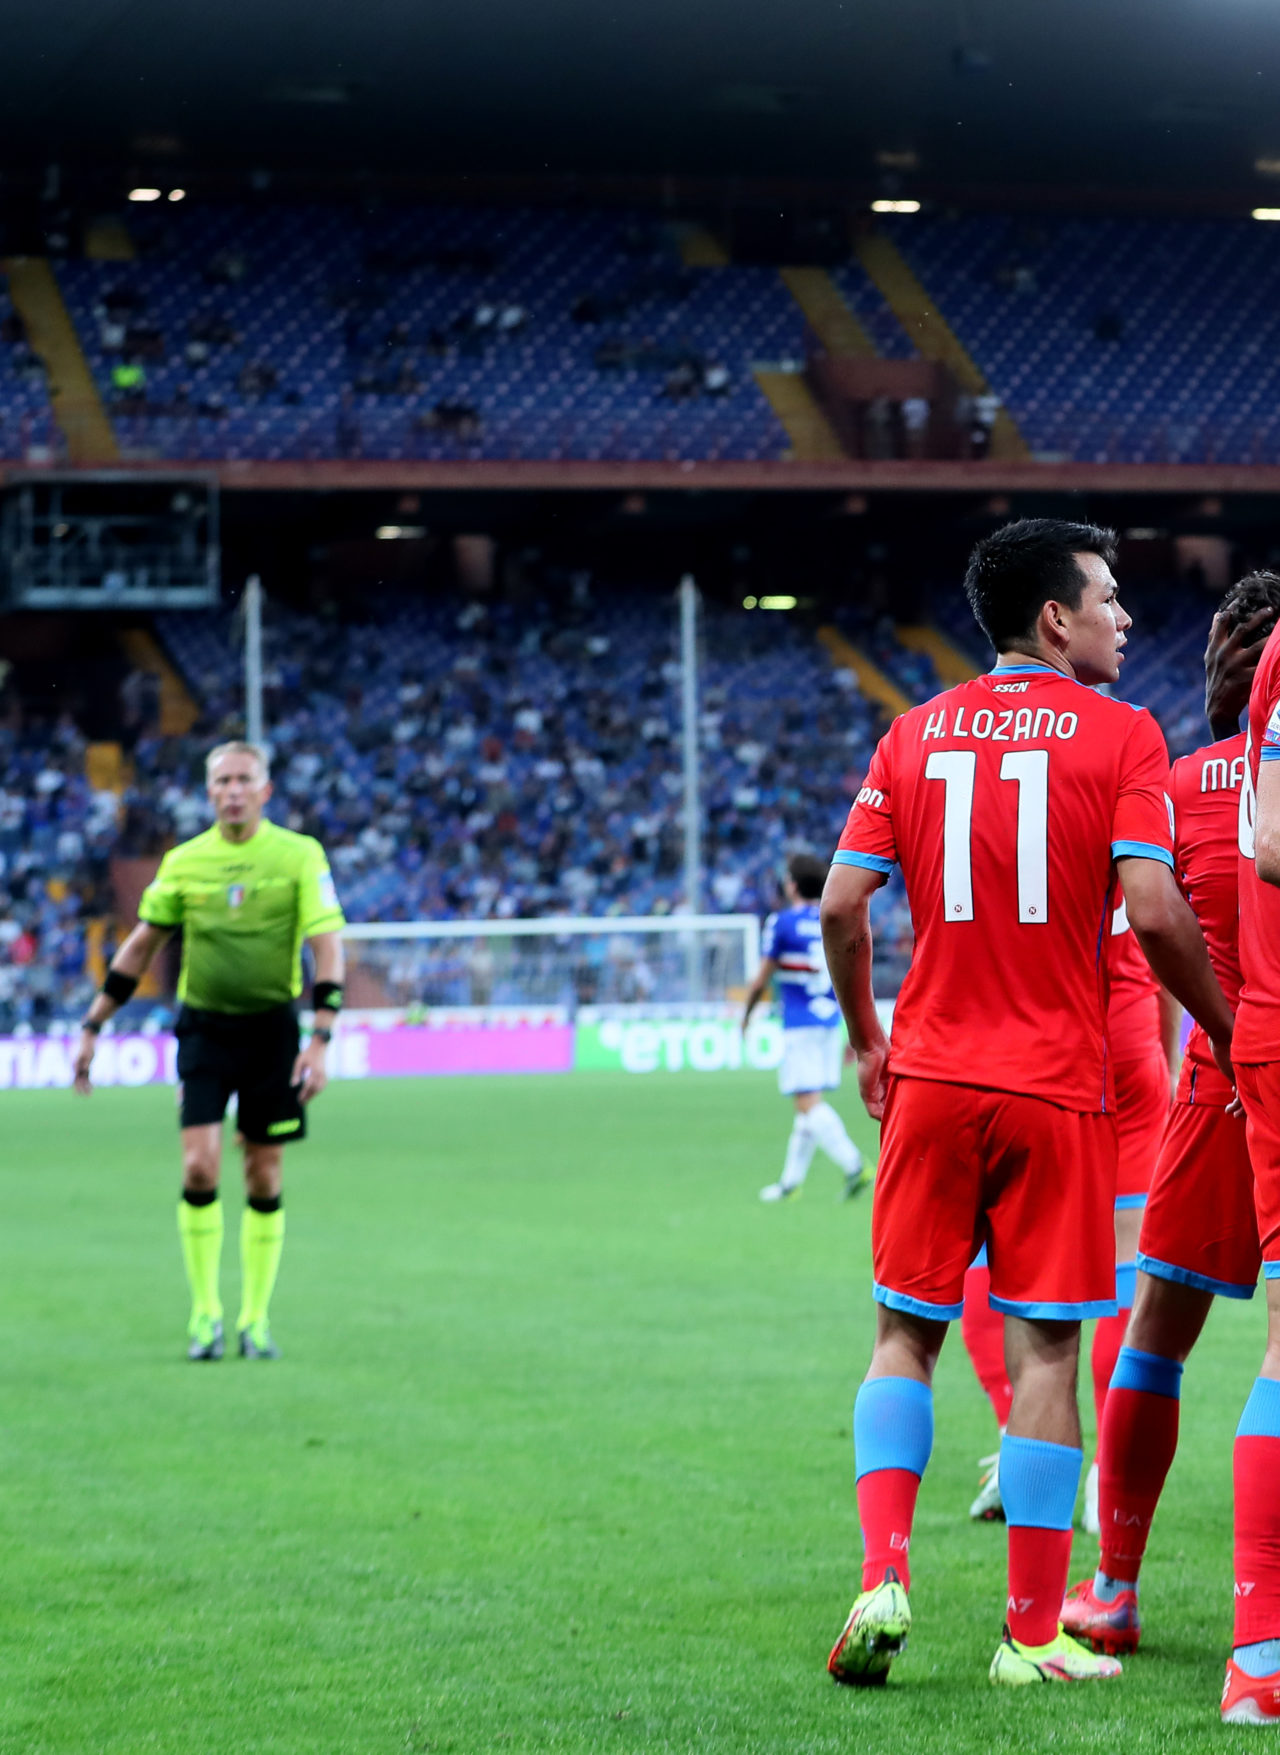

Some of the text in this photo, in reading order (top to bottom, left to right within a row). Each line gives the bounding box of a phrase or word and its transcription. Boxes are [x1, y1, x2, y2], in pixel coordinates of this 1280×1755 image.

[992, 681, 1030, 693] SSCN
[952, 707, 1079, 742] LOZANO
[924, 749, 1049, 924] 11
